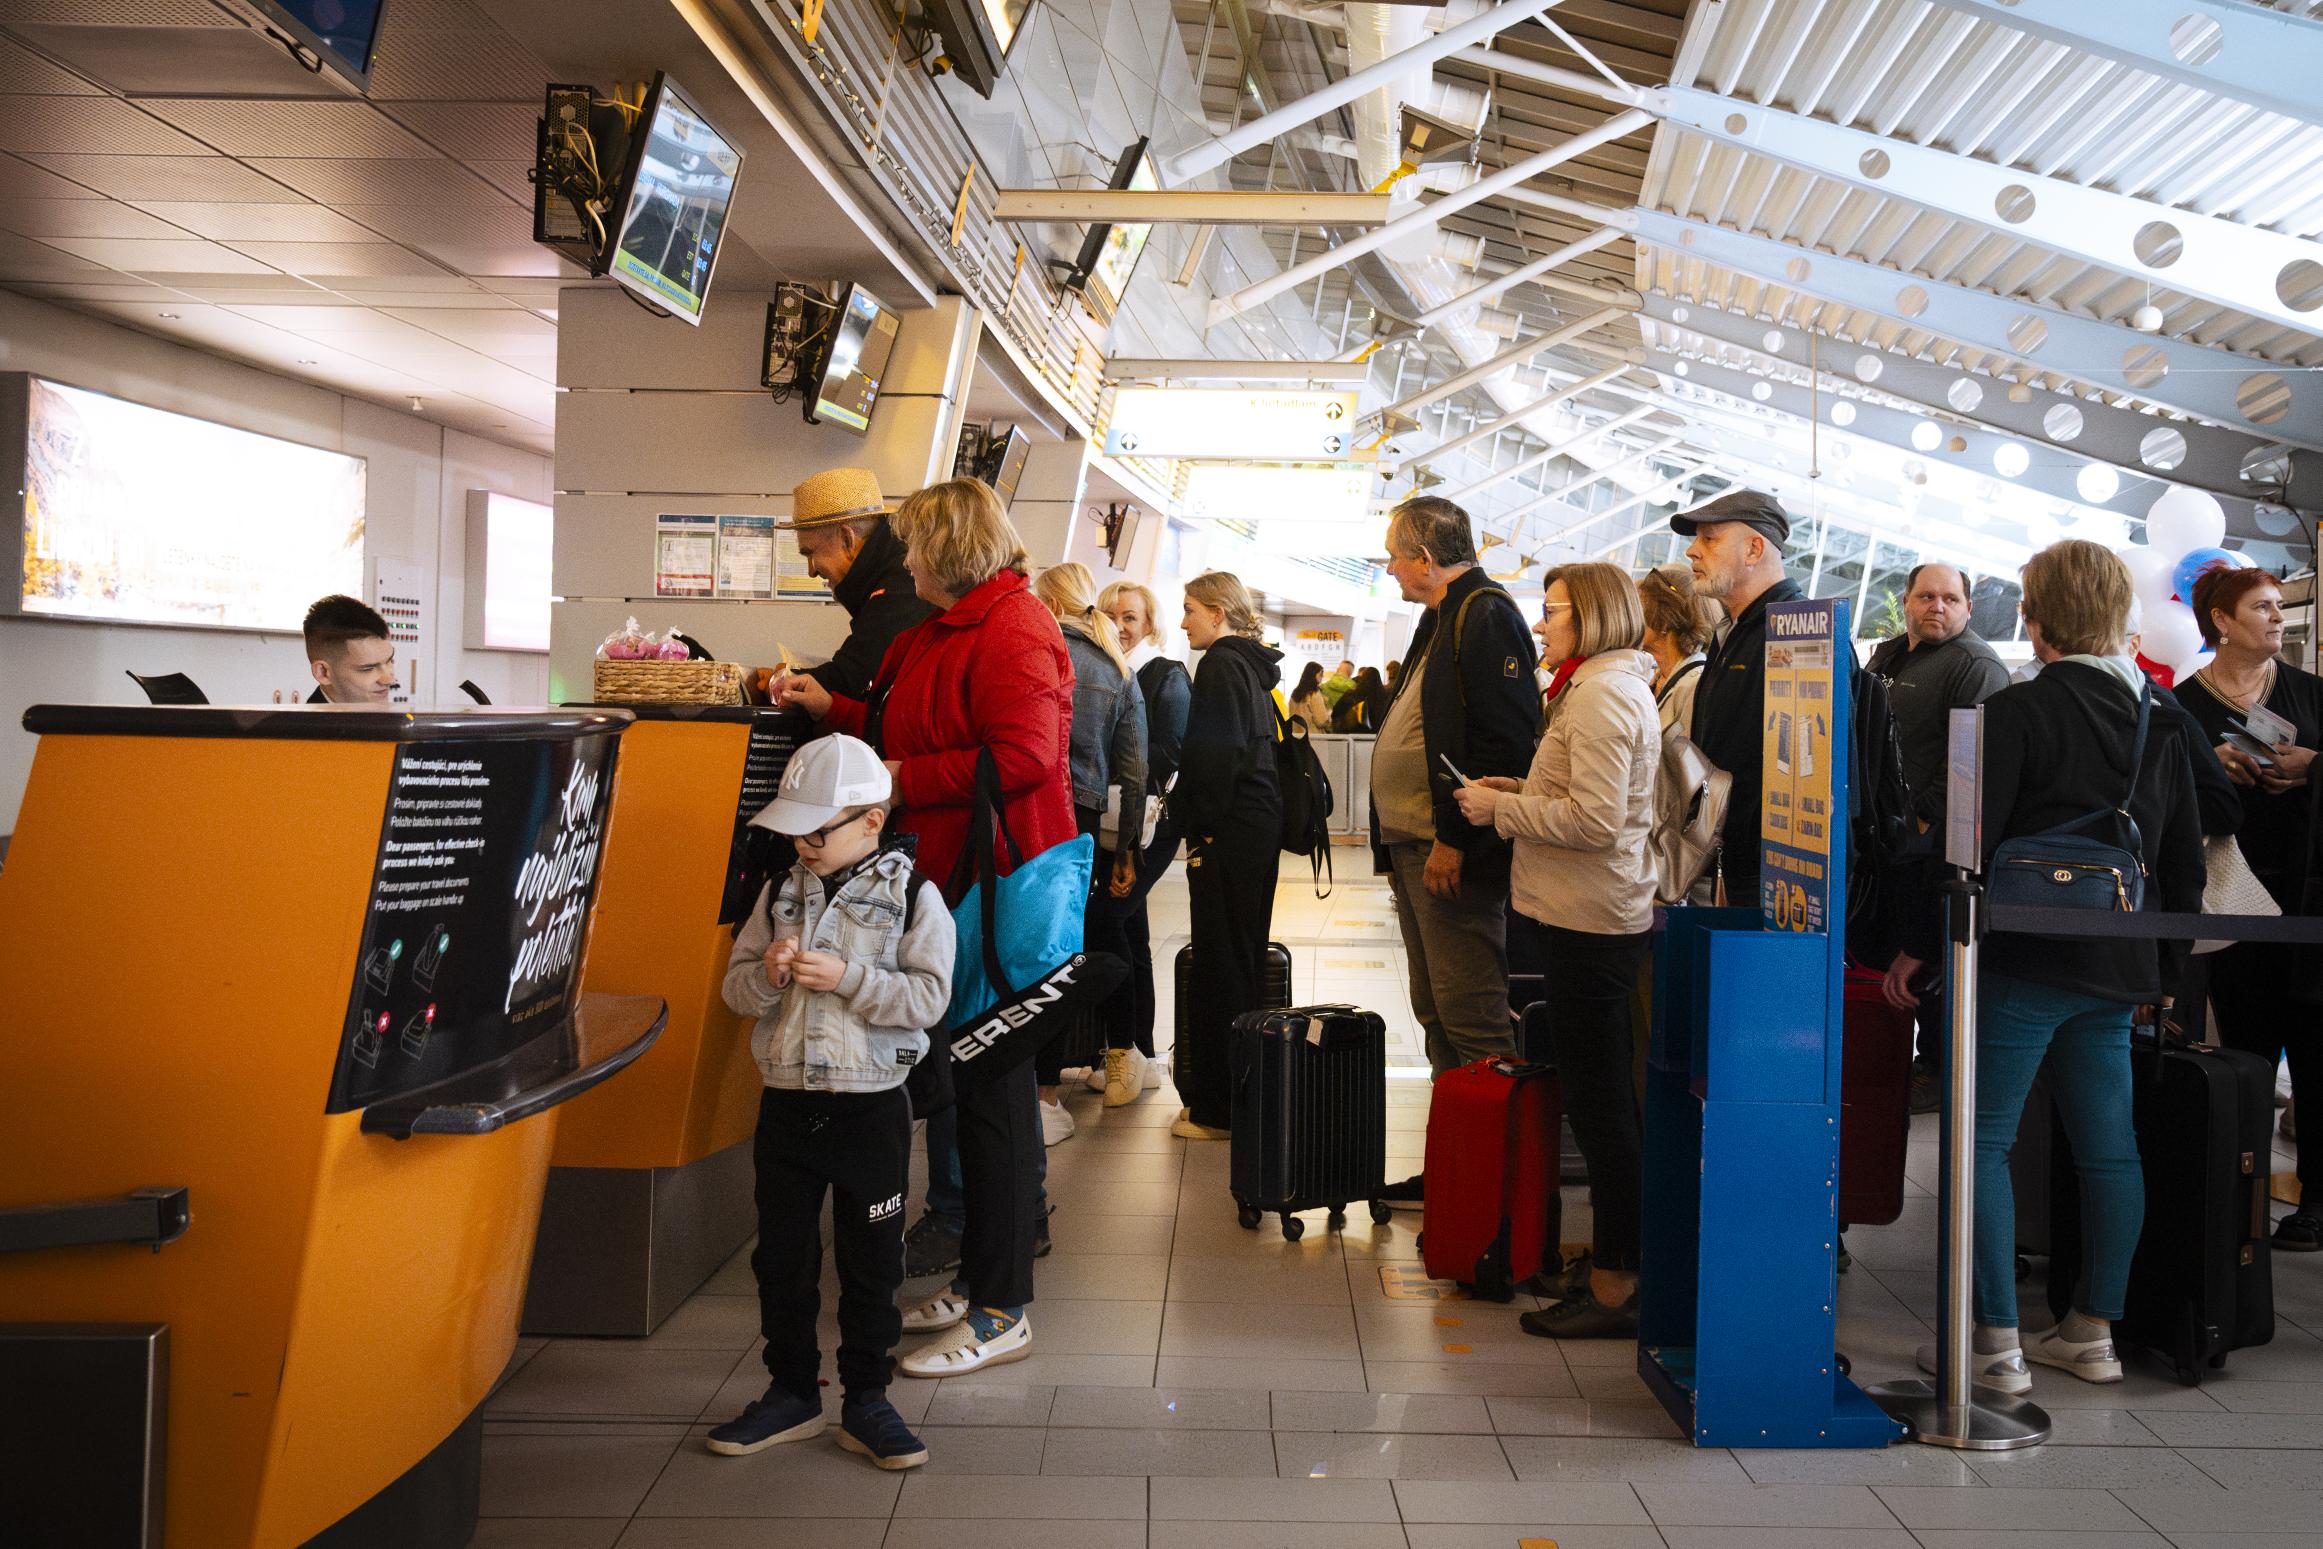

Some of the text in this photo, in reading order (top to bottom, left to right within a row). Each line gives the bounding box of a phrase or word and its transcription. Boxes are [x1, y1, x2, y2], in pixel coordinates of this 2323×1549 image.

[1318, 631, 1338, 641] GATE
[1777, 611, 1828, 636] RYANAIR
[385, 840, 402, 852] Dear
[951, 963, 1077, 1062] ERENT
[869, 1192, 902, 1219] SKATE
